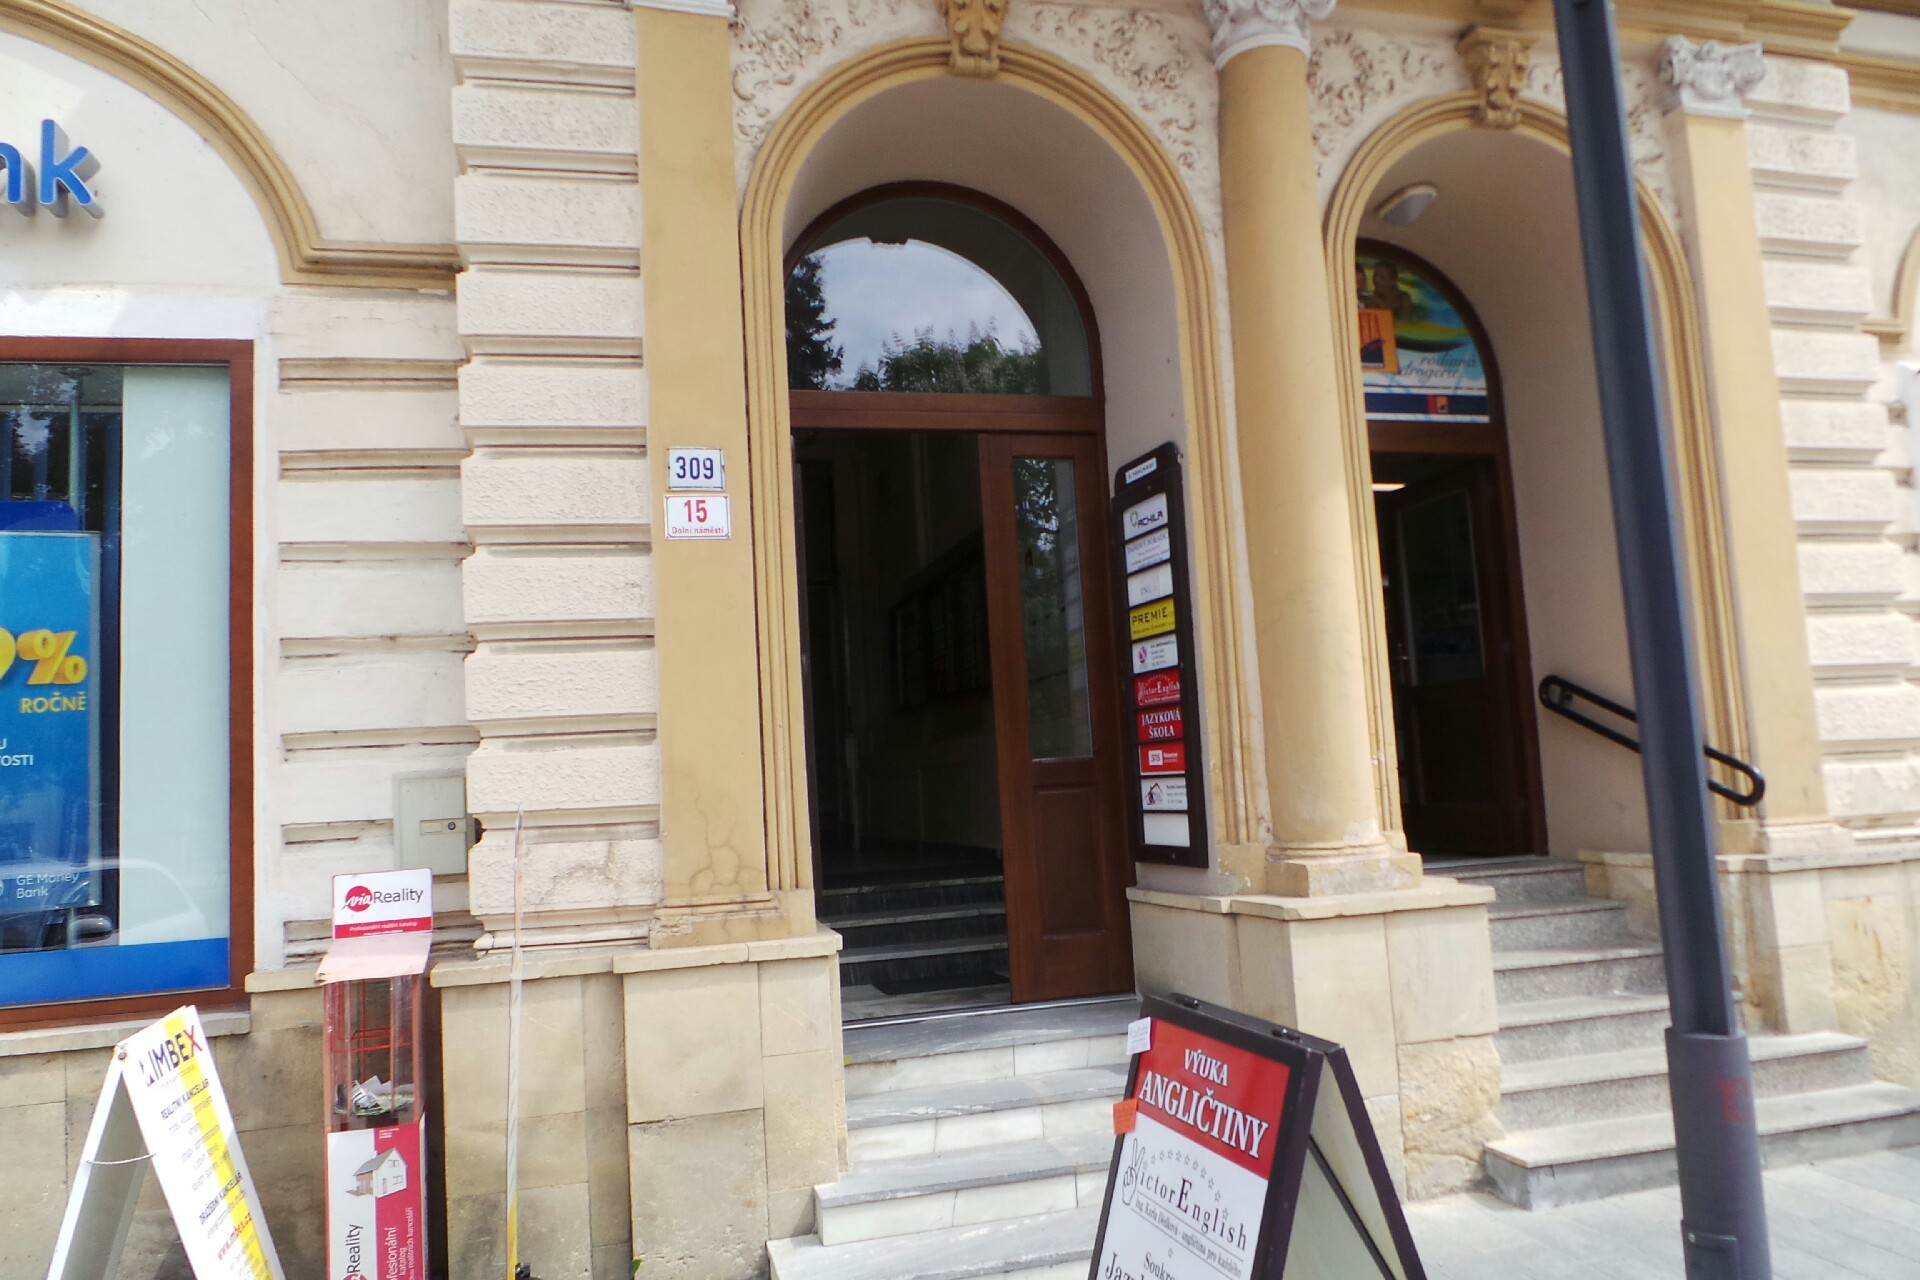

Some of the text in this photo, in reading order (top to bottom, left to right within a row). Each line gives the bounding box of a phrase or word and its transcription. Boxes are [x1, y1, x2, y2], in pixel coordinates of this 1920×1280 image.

[675, 456, 714, 480] 309
[684, 499, 708, 523] 15
[671, 526, 724, 535] Dolní náměstí
[1132, 606, 1168, 624] PREMIE
[20, 691, 87, 713] ROČNĚ
[1141, 707, 1181, 726] JAZYKOVÁ
[1149, 725, 1175, 739] ŠKOLA
[0, 754, 34, 767] OSTI
[16, 872, 80, 886] GE Money
[16, 886, 49, 899] Bank
[1184, 1048, 1228, 1087] VÝUKA
[1138, 1070, 1268, 1159] ANGLIČTINY
